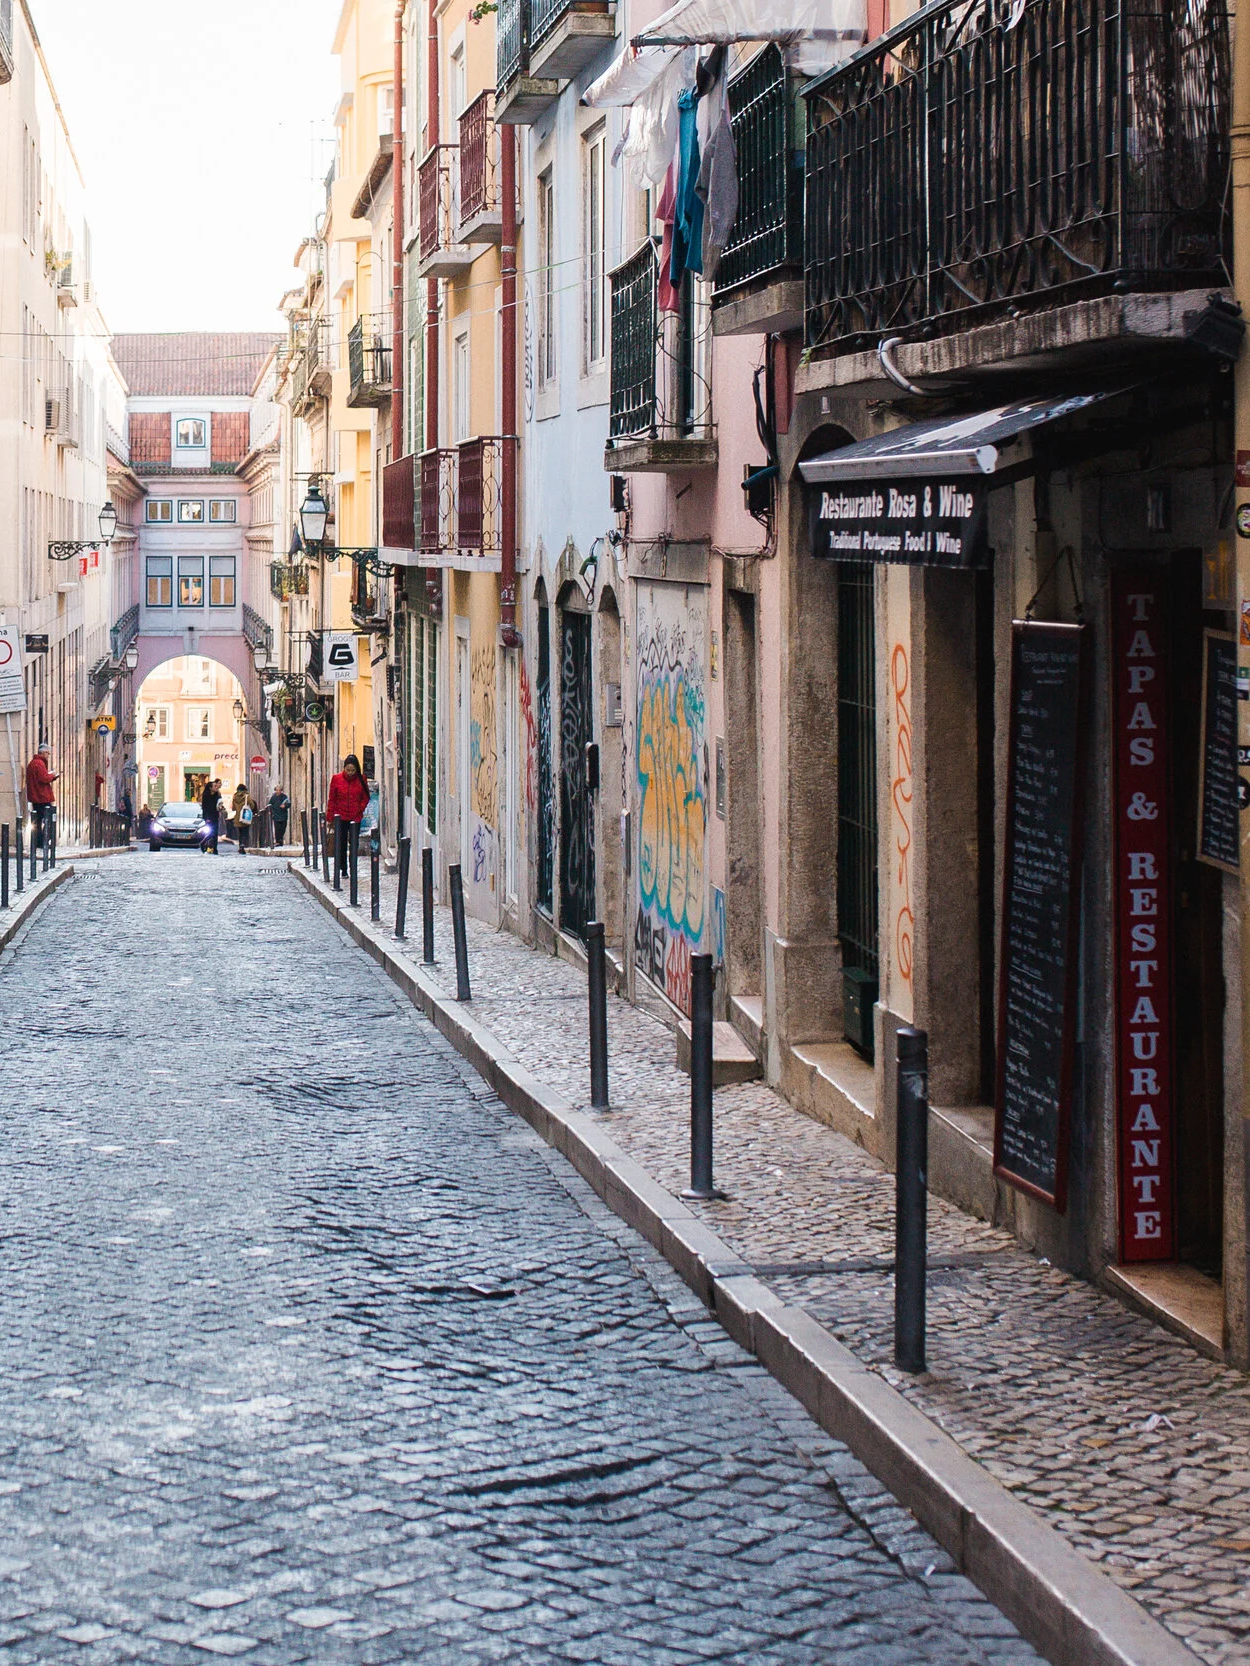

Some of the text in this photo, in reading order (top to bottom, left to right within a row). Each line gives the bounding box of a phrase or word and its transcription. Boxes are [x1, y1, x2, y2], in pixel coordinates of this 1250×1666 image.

[819, 485, 974, 520] Restaurante Rosa & Wine
[904, 530, 926, 552] Food
[936, 531, 962, 555] Wine
[334, 671, 351, 679] BAR
[1126, 593, 1156, 767] TAPAS
[1127, 792, 1158, 821] &
[1128, 852, 1161, 1240] RESTAURANTE
